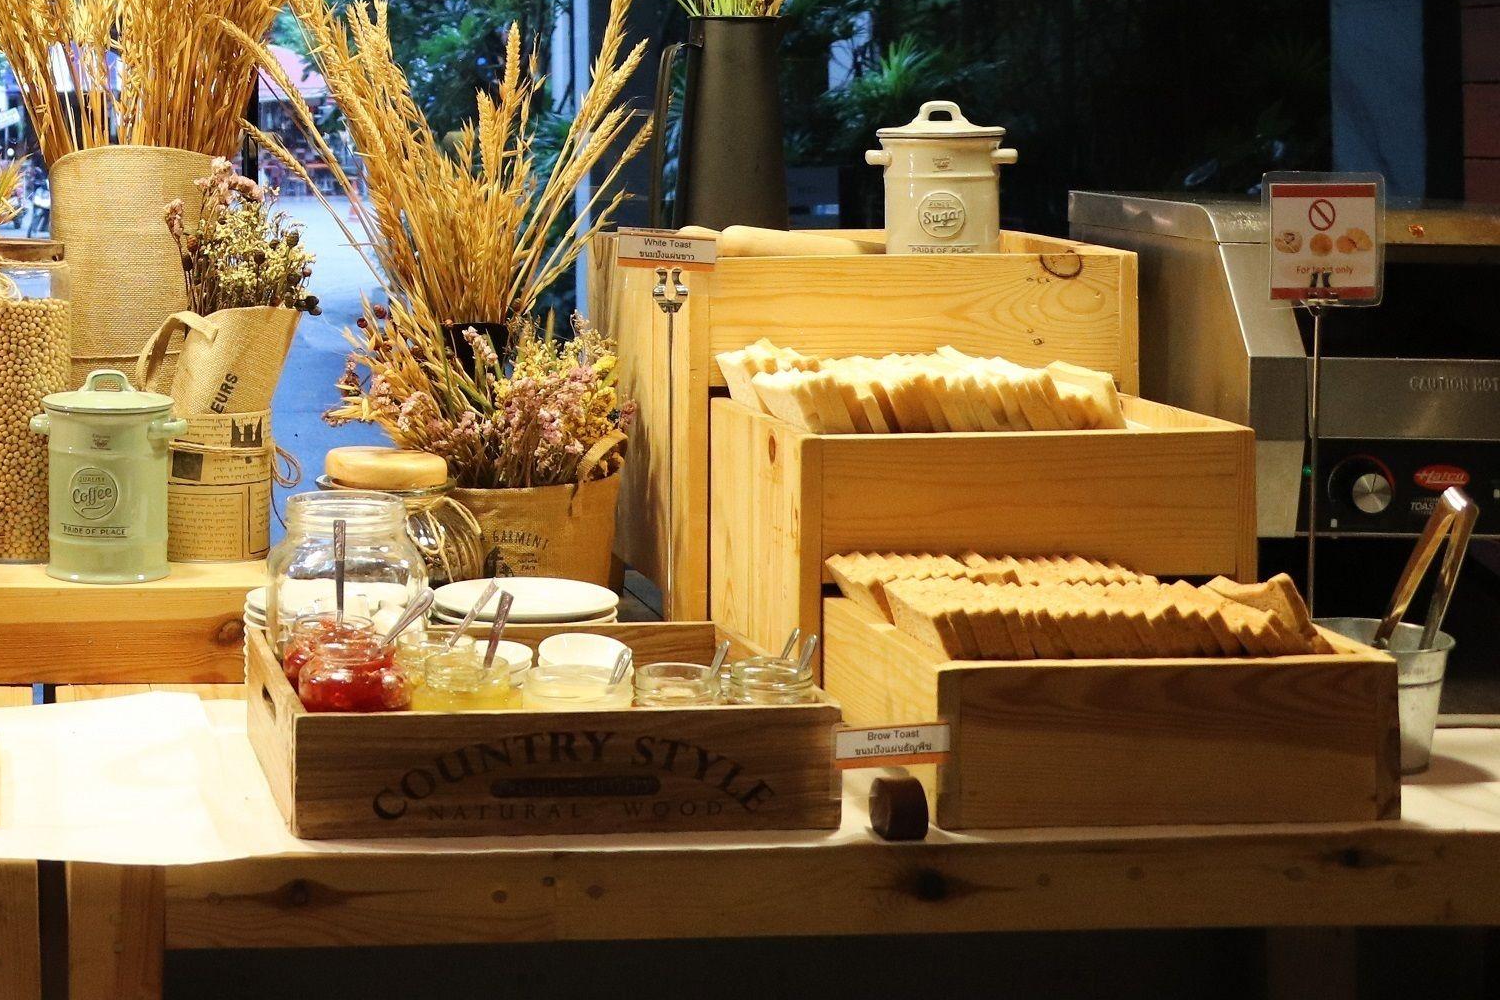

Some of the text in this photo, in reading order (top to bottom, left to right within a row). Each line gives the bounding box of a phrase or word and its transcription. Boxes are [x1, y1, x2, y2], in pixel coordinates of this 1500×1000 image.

[923, 210, 962, 225] Sugar
[644, 238, 691, 249] White Toast
[1297, 266, 1311, 274] For
[1335, 265, 1354, 276] only
[1410, 376, 1500, 391] CAUTION HOT
[211, 373, 239, 414] EURS
[72, 487, 112, 506] Coffee
[1410, 502, 1435, 510] TOAS
[63, 525, 83, 534] PRIDE
[100, 528, 126, 536] PLACE
[867, 729, 920, 740] Brow Toast
[372, 730, 776, 820] COUNTRY STYLE
[428, 801, 724, 820] NATURAL WOOD
